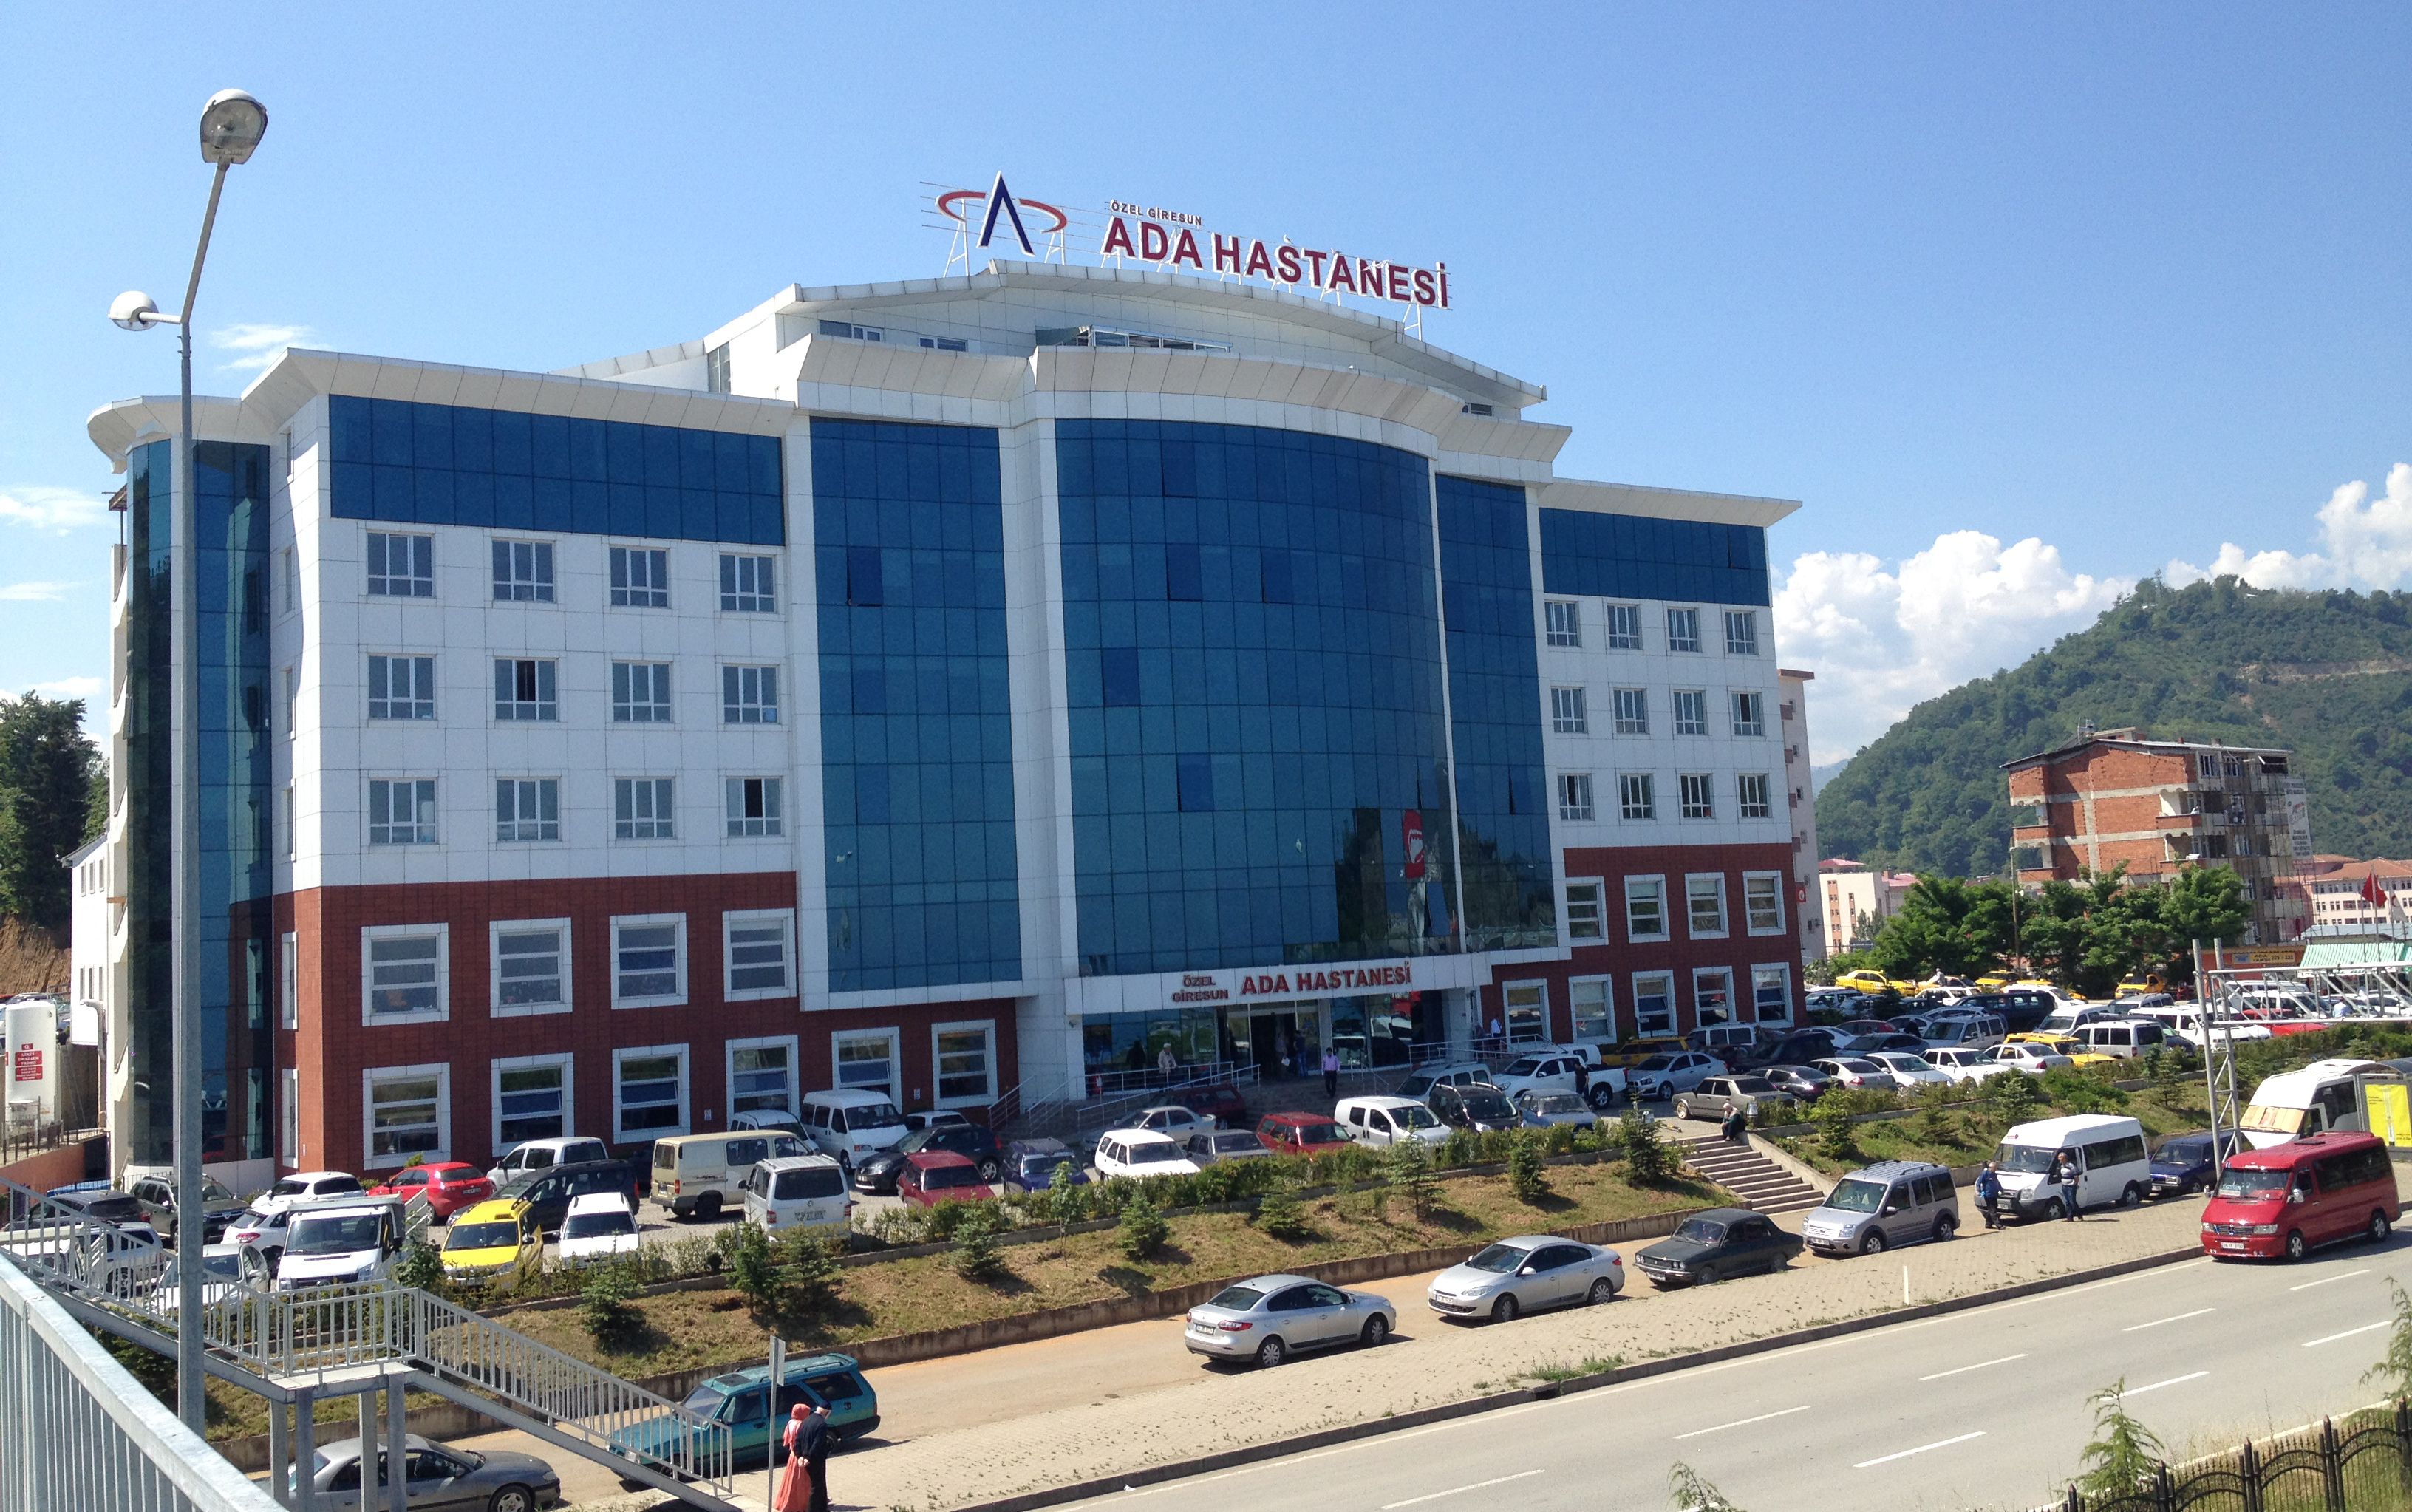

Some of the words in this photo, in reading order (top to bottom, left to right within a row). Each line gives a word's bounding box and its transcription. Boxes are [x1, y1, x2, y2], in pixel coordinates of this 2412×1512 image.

[1111, 199, 1144, 216] ÖZEL
[1148, 206, 1202, 225] GİRESUN
[1102, 216, 1204, 270] ADA
[1212, 233, 1449, 309] HASTANESİ
[1182, 974, 1216, 987] ÖZEL
[1241, 973, 1290, 996] ADA
[1296, 960, 1411, 992] HASTANESİ
[1172, 988, 1229, 1003] GİRESUN
